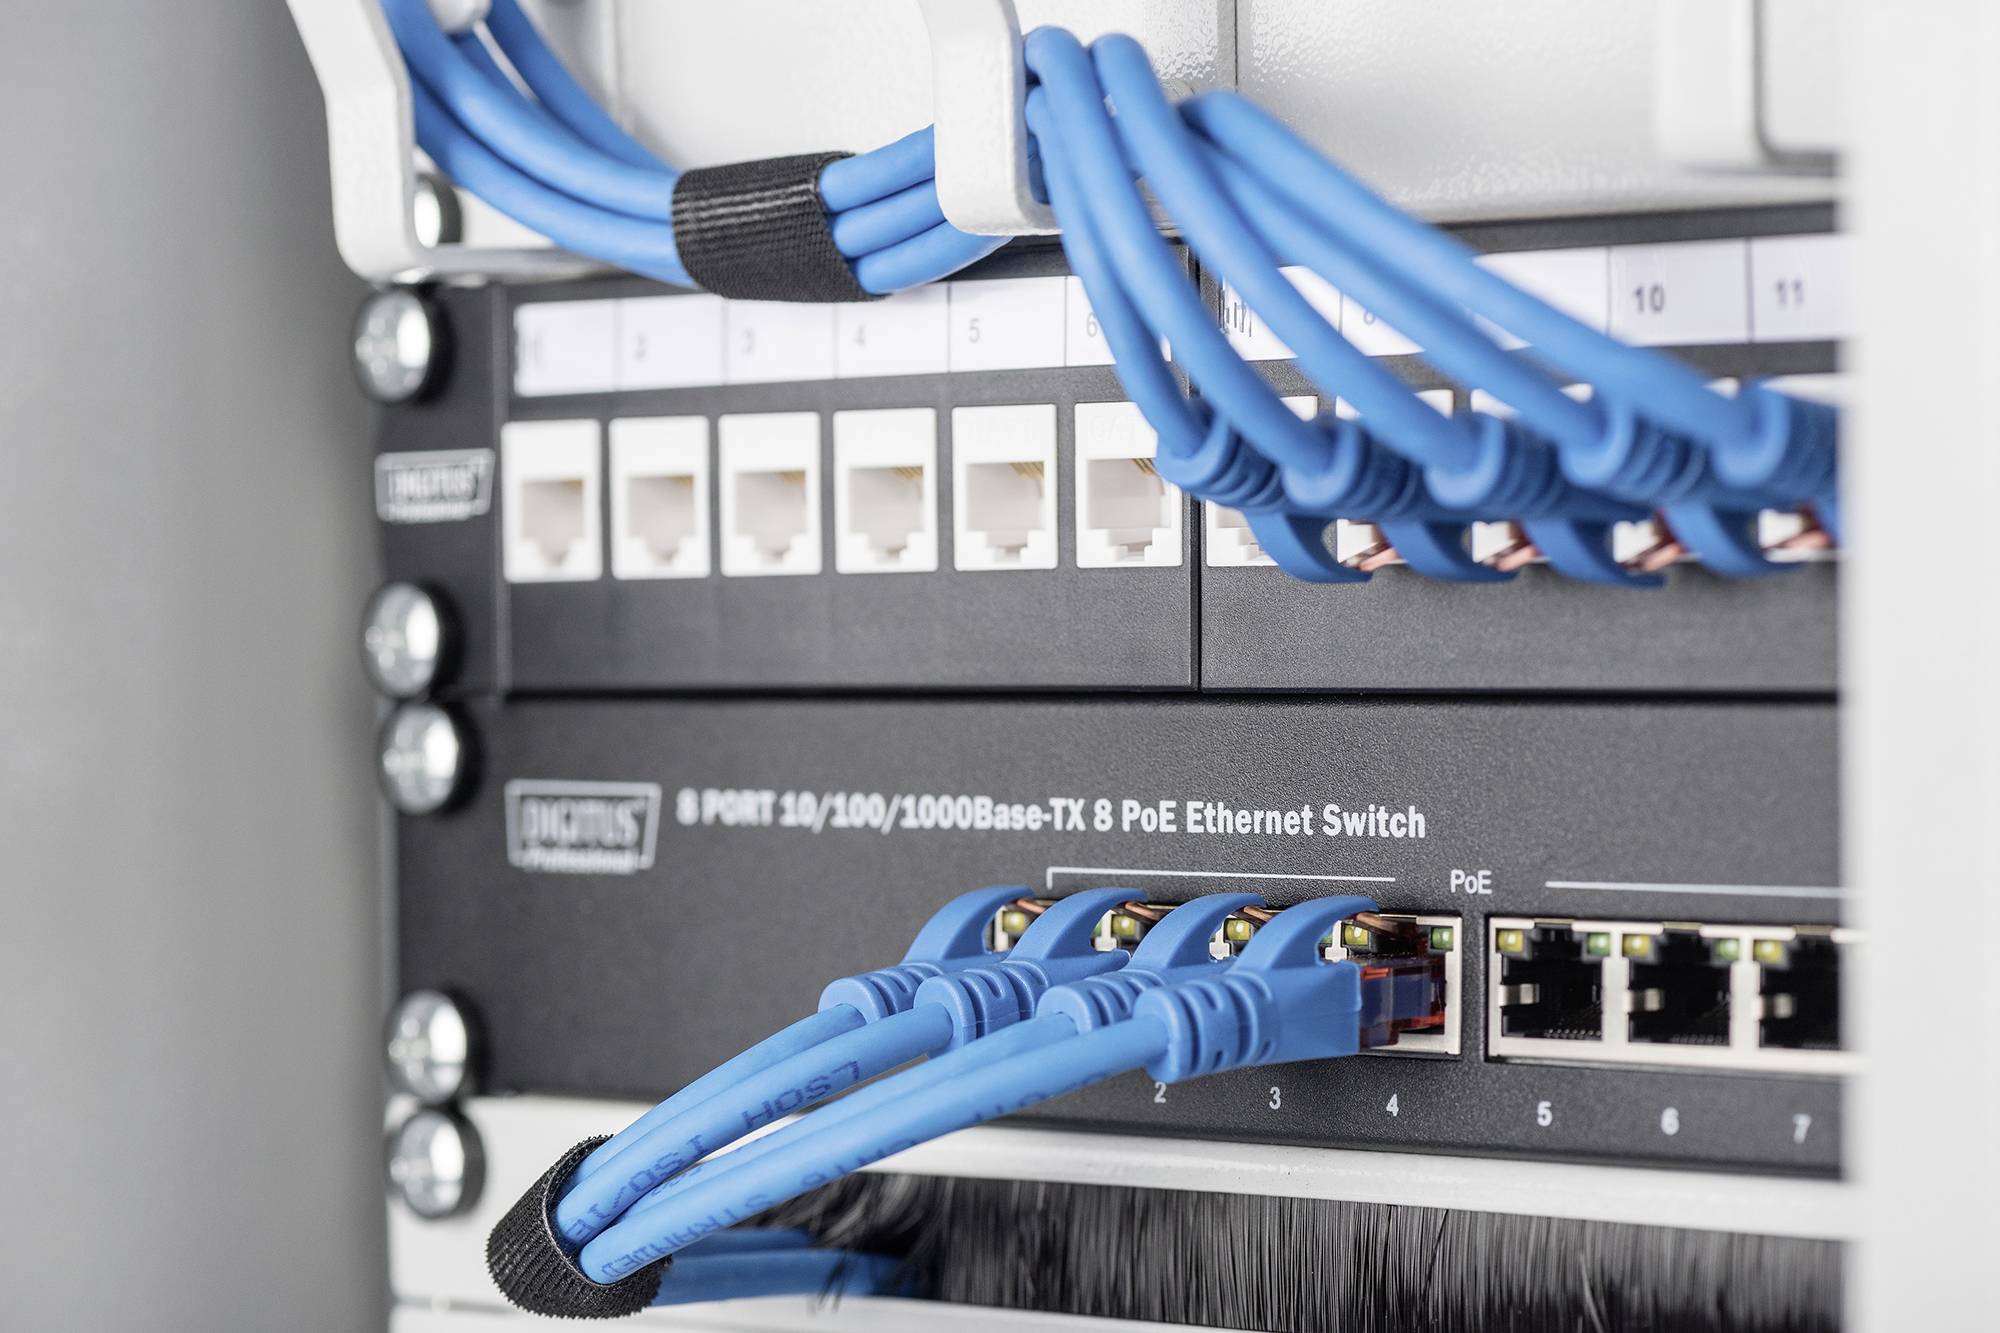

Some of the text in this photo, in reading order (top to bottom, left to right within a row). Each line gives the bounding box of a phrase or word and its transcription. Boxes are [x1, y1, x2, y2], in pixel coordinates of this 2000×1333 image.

[1634, 284, 1665, 314] 10
[1774, 278, 1805, 308] 11
[968, 317, 982, 344] 5
[1086, 312, 1098, 338] 6
[676, 787, 1426, 838] 8 PORT 10/100/1000Base-TX 8 PoE Ethernet Switch
[1449, 868, 1493, 895] PoE
[1154, 1081, 1167, 1104] 2
[1268, 1086, 1281, 1110] 3
[1385, 1093, 1400, 1117] 4
[1536, 1101, 1554, 1127] 5
[1660, 1107, 1680, 1136] 6
[1791, 1113, 1812, 1144] 7
[565, 1134, 706, 1244] ISO/IE
